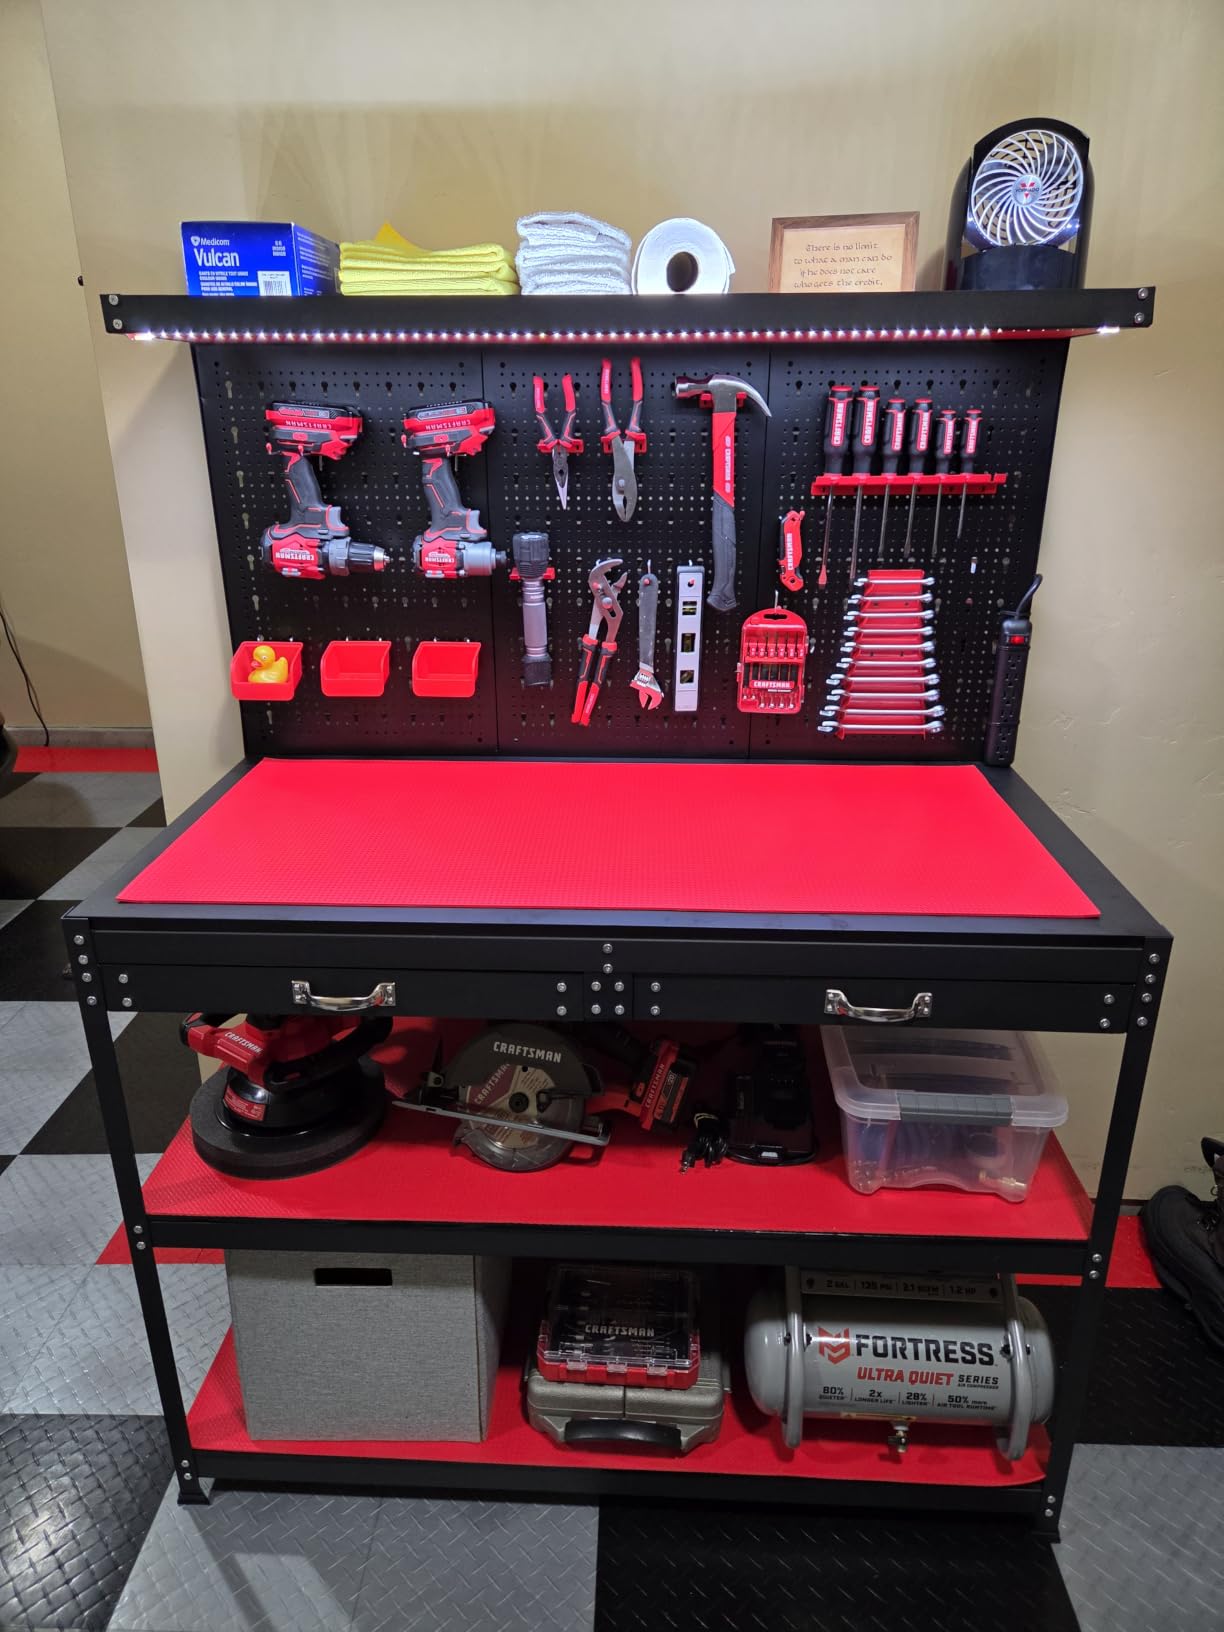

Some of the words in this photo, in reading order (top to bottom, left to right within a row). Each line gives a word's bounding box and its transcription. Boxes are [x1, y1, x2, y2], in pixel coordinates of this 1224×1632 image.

[200, 237, 230, 246] Medicom
[806, 244, 831, 252] There
[856, 242, 880, 250] limit
[194, 248, 240, 267] Vulcan
[800, 269, 806, 278] if
[286, 420, 332, 429] CRAFTSMAN
[425, 420, 471, 430] CRAFTSMAN
[834, 402, 845, 445] CRAFTSMAN
[863, 400, 874, 443] CRAFTSMAN
[893, 412, 904, 449] CRAFTSMAN
[919, 412, 930, 449] CRAFTSMAN
[275, 552, 315, 561] CRAFTSMAN
[224, 1032, 263, 1054] CRAFTSMAN
[493, 1041, 562, 1063] CRAFTSMAN
[474, 1063, 510, 1104] CRAFTSMA
[645, 1064, 665, 1108] CRAFTSMAN
[585, 1324, 655, 1337] CRAFTSMAN
[855, 1334, 994, 1366] FORTRESS
[857, 1367, 904, 1382] ULTRA
[908, 1370, 954, 1386] QUIET
[958, 1374, 999, 1385] SERIES
[823, 1386, 844, 1395] 80%
[869, 1389, 882, 1398] 2x
[906, 1392, 927, 1401] 28%
[947, 1395, 968, 1404] 50%
